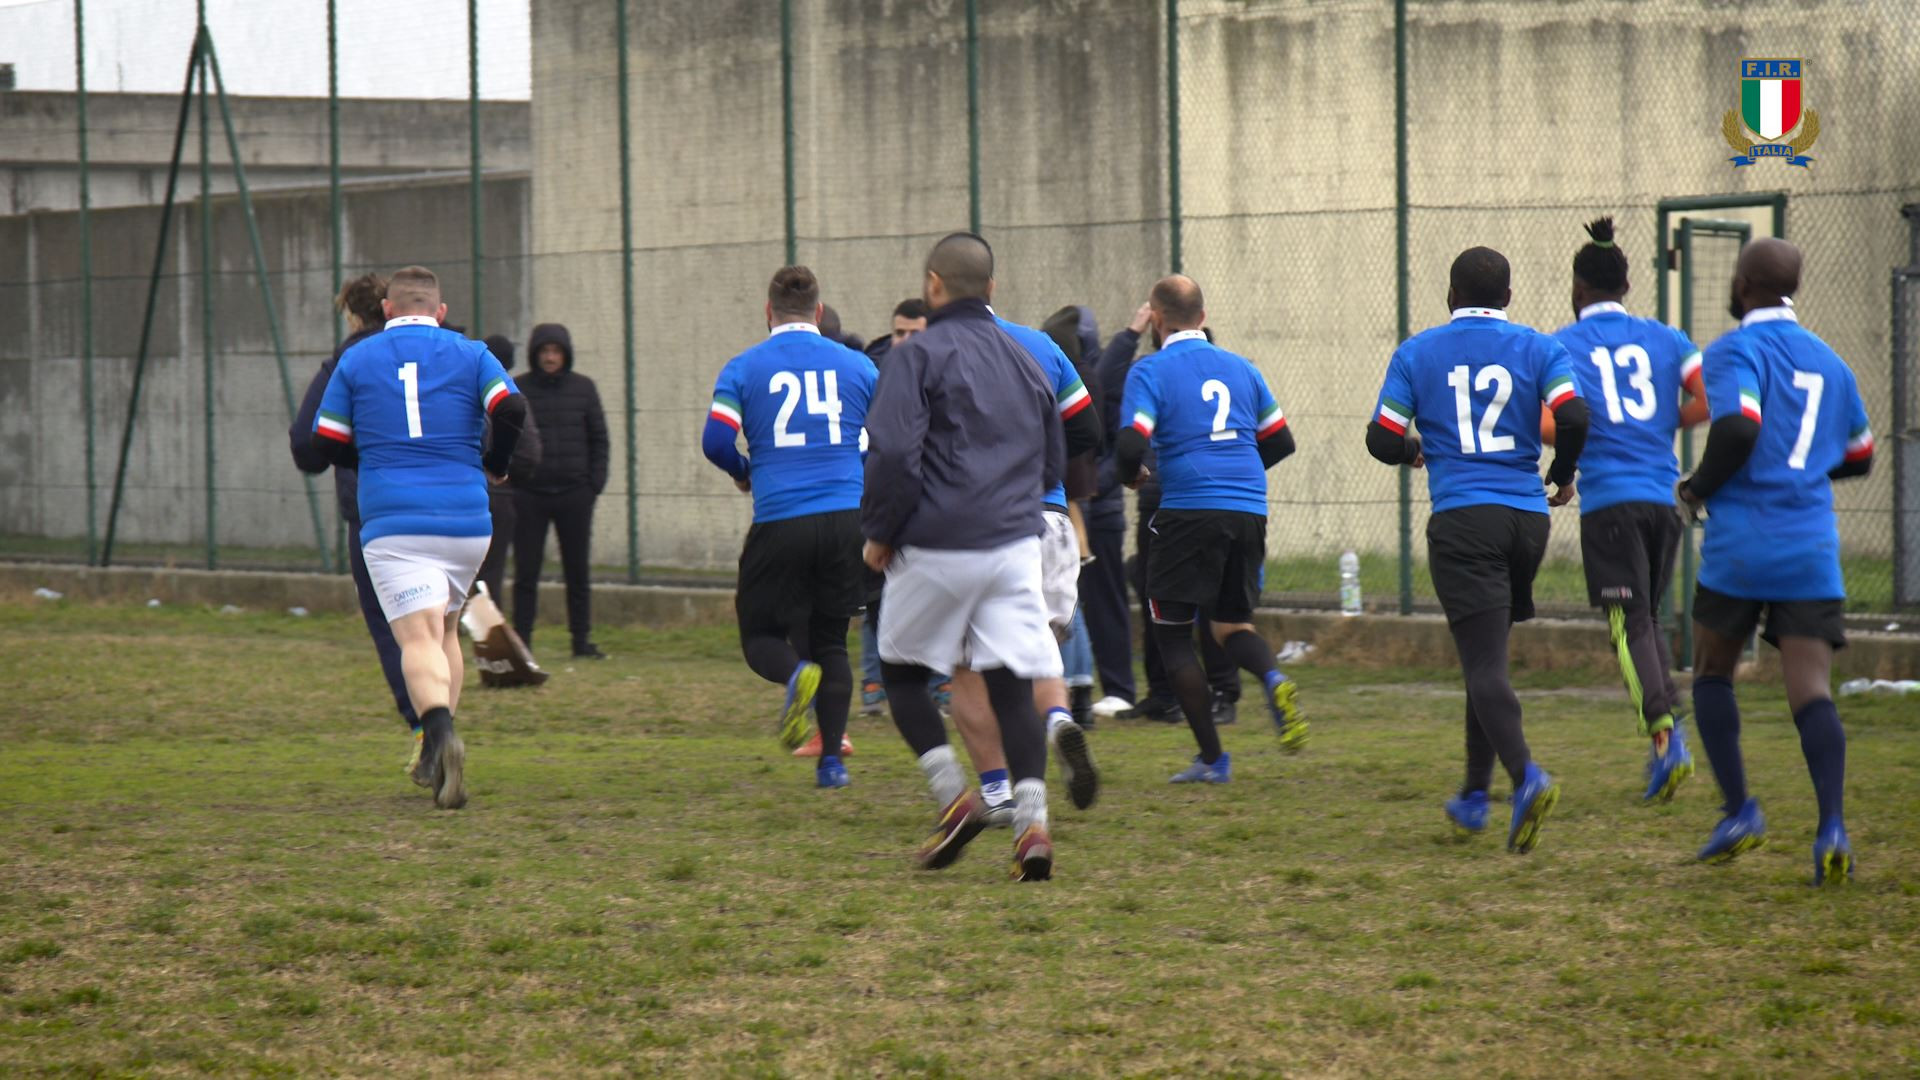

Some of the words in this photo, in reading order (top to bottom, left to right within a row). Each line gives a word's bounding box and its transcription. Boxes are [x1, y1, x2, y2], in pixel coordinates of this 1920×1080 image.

[398, 361, 424, 438] 1
[768, 369, 843, 448] 24
[1200, 379, 1238, 441] 2
[1447, 364, 1516, 455] 12
[1589, 343, 1657, 425] 13
[1787, 370, 1825, 470] 7
